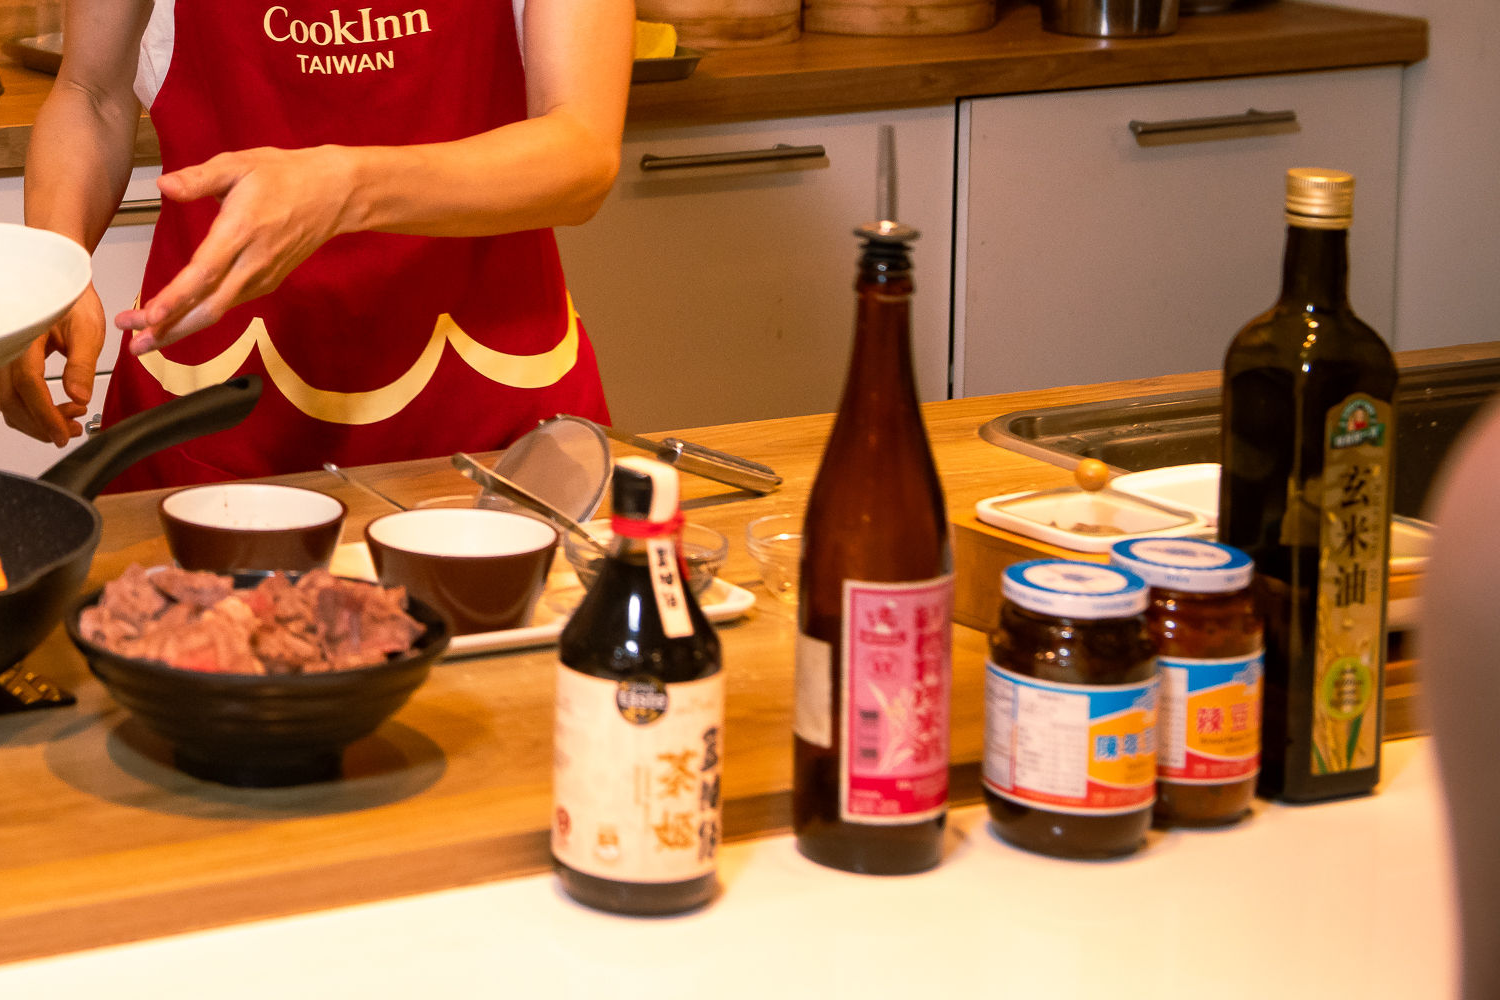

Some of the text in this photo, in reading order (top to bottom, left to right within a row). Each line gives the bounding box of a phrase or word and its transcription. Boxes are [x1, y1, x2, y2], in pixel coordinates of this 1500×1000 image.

[263, 5, 432, 46] CookInn
[296, 50, 395, 75] TAIWAN
[1333, 465, 1372, 608] 玄米油
[1197, 702, 1261, 734] 辣豆
